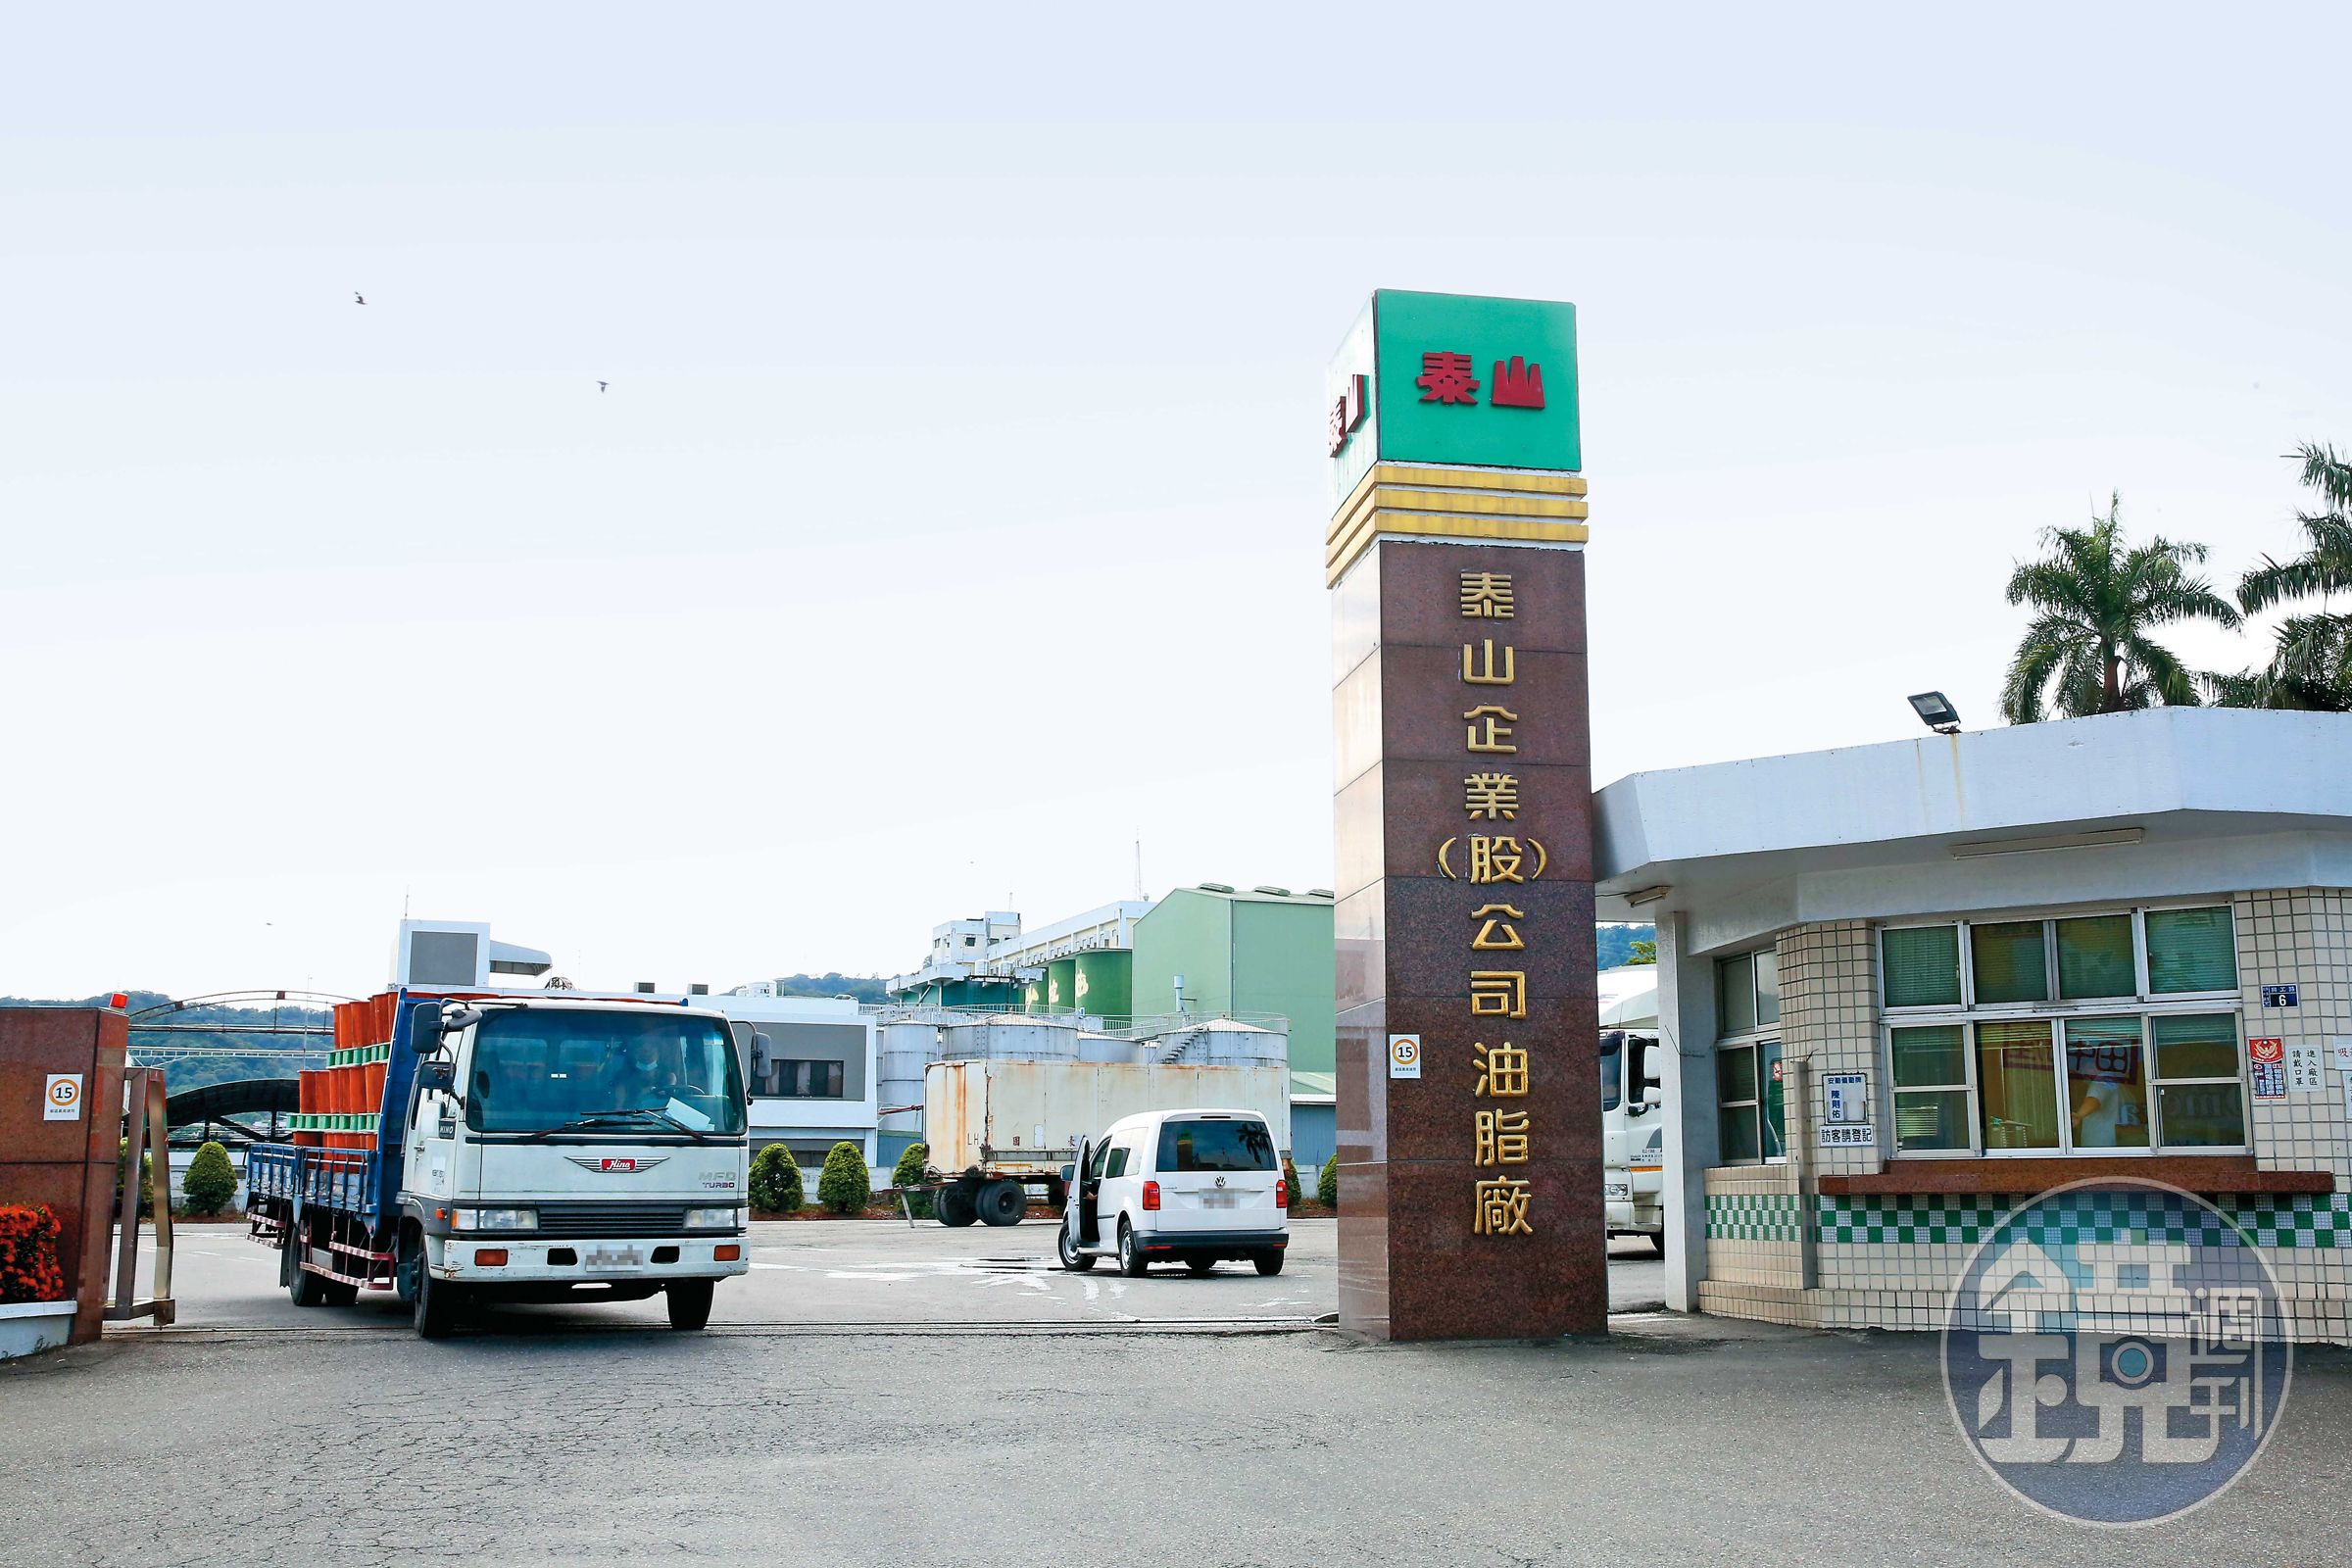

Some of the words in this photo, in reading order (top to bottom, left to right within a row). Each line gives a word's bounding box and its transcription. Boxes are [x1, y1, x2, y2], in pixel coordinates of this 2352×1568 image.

[1415, 351, 1545, 410] 泰山
[1438, 571, 1547, 1236] 泰山企業(股)公司油脂廠
[2278, 994, 2286, 1006] 6
[1397, 1047, 1413, 1057] 15
[2291, 1050, 2304, 1086] 請戴口罩
[2306, 1050, 2319, 1086] 進入廠區
[55, 1087, 73, 1099] 15
[1821, 1128, 1872, 1143] 訪客請登記
[607, 1158, 631, 1171] Hino
